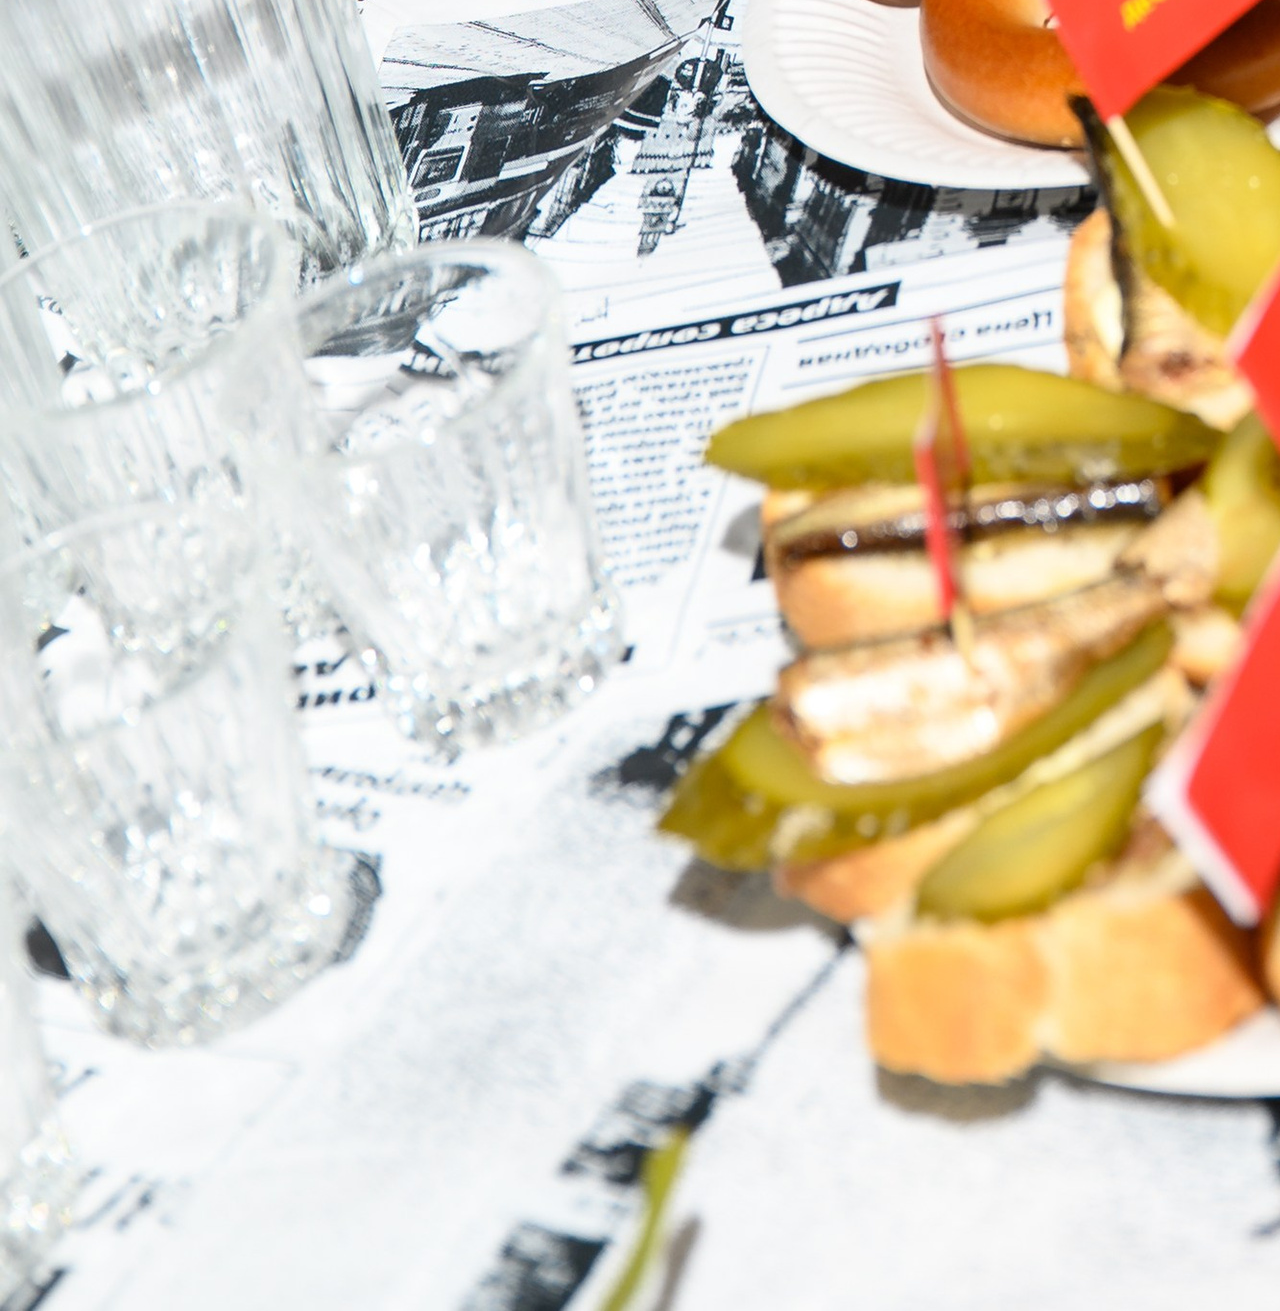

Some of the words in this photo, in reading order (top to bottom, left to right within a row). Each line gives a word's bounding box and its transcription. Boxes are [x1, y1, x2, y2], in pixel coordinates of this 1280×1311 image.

[728, 287, 887, 341] Адреса
[976, 310, 1052, 335] Цена
[799, 330, 965, 368] сободная
